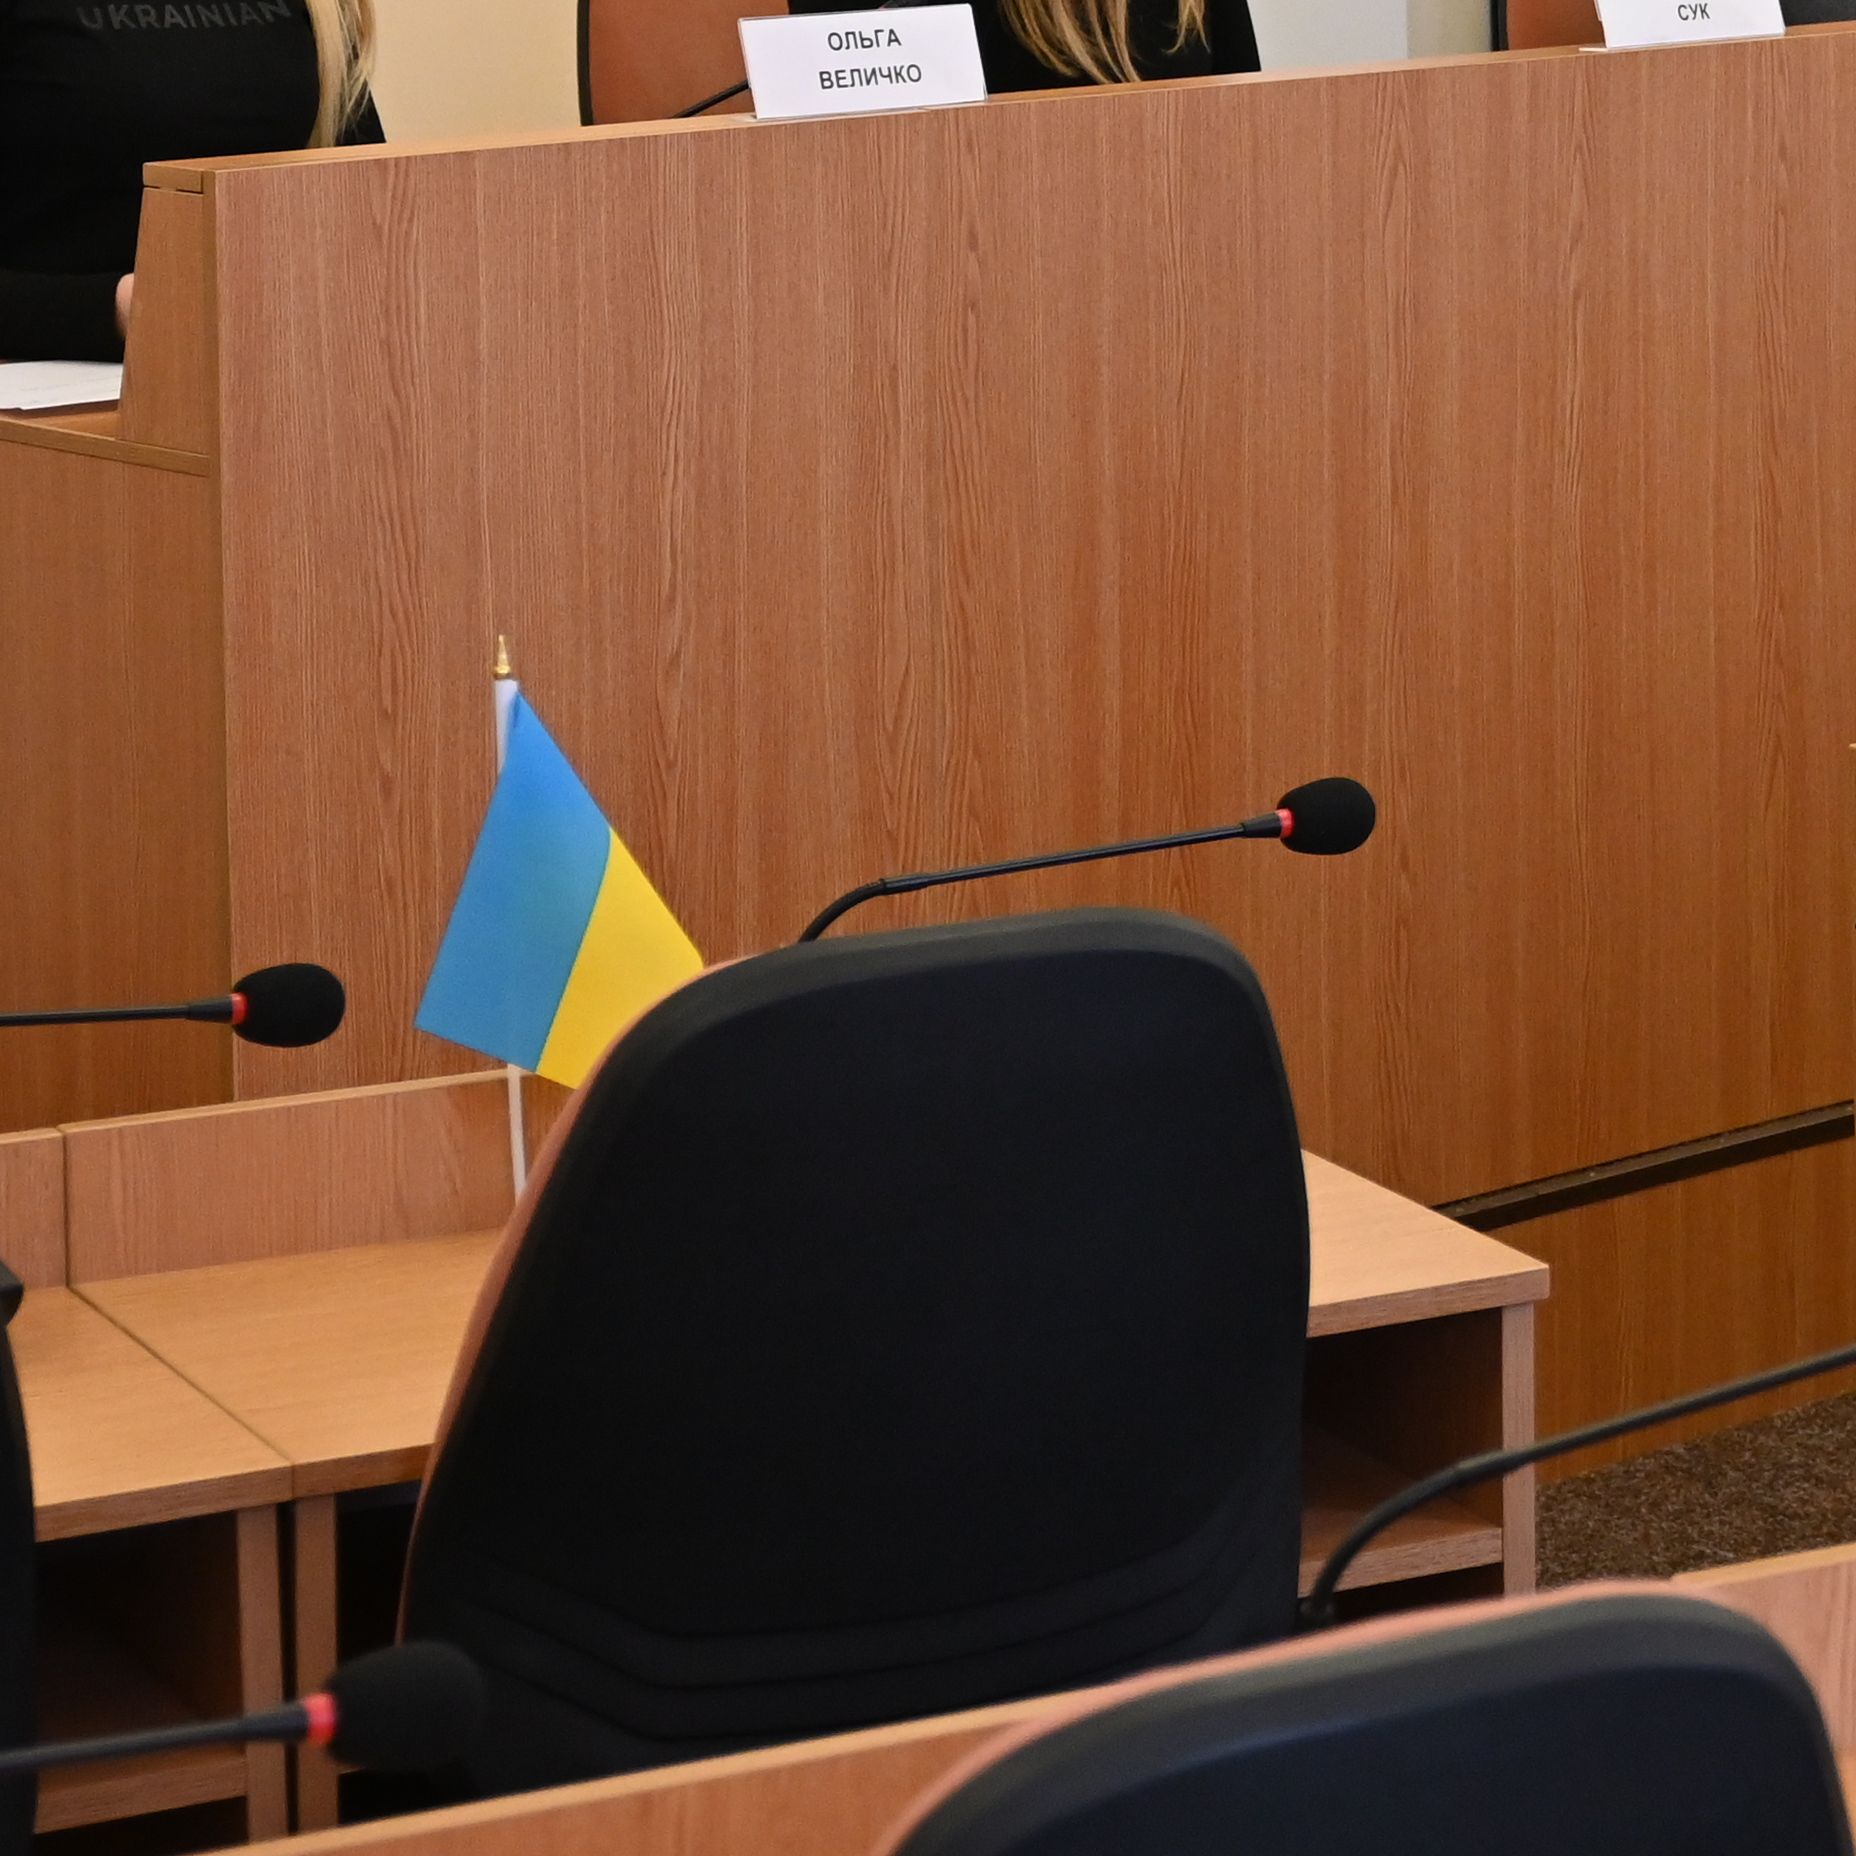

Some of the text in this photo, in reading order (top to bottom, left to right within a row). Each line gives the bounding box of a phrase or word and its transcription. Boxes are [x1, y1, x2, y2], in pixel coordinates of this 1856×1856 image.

[1677, 3, 1711, 21] СУК
[827, 28, 902, 52] ОЛЬГА
[819, 63, 922, 90] ВЕЛИЧКО
